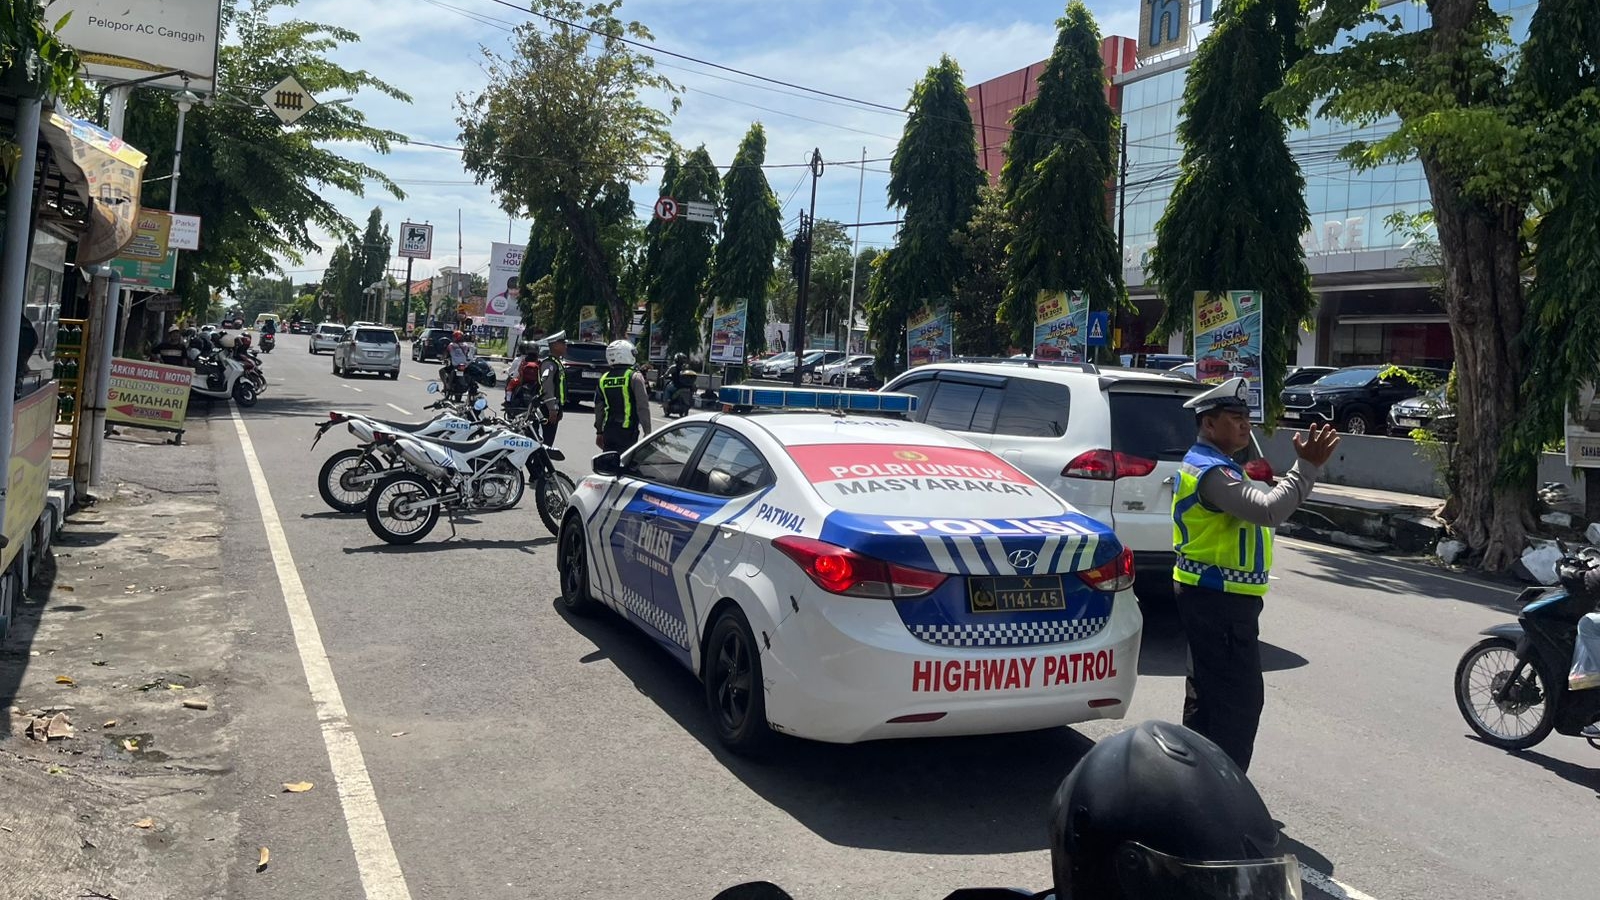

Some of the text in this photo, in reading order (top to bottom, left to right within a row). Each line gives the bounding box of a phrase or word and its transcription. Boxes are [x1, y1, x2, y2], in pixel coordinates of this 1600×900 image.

[88, 16, 205, 42] Pelopor AC Canggih
[1301, 216, 1364, 257] ARE
[503, 258, 521, 266] HOU
[1213, 322, 1243, 342] BCA
[137, 368, 159, 379] MOBIL
[165, 372, 191, 384] MOTOR
[119, 393, 183, 409] MATAHARI
[446, 422, 471, 430] POLISI
[504, 439, 532, 448] POLISI
[830, 463, 1012, 482] POLRI UNTUK
[834, 477, 1034, 498] MASYARAKAT
[756, 503, 806, 534] PATWAL
[882, 519, 1097, 536] POLISI
[638, 521, 674, 563] POLISI
[1023, 578, 1033, 589] X
[1002, 591, 1058, 608] 1141-45
[912, 649, 1118, 692] HIGHWAY PATROL
